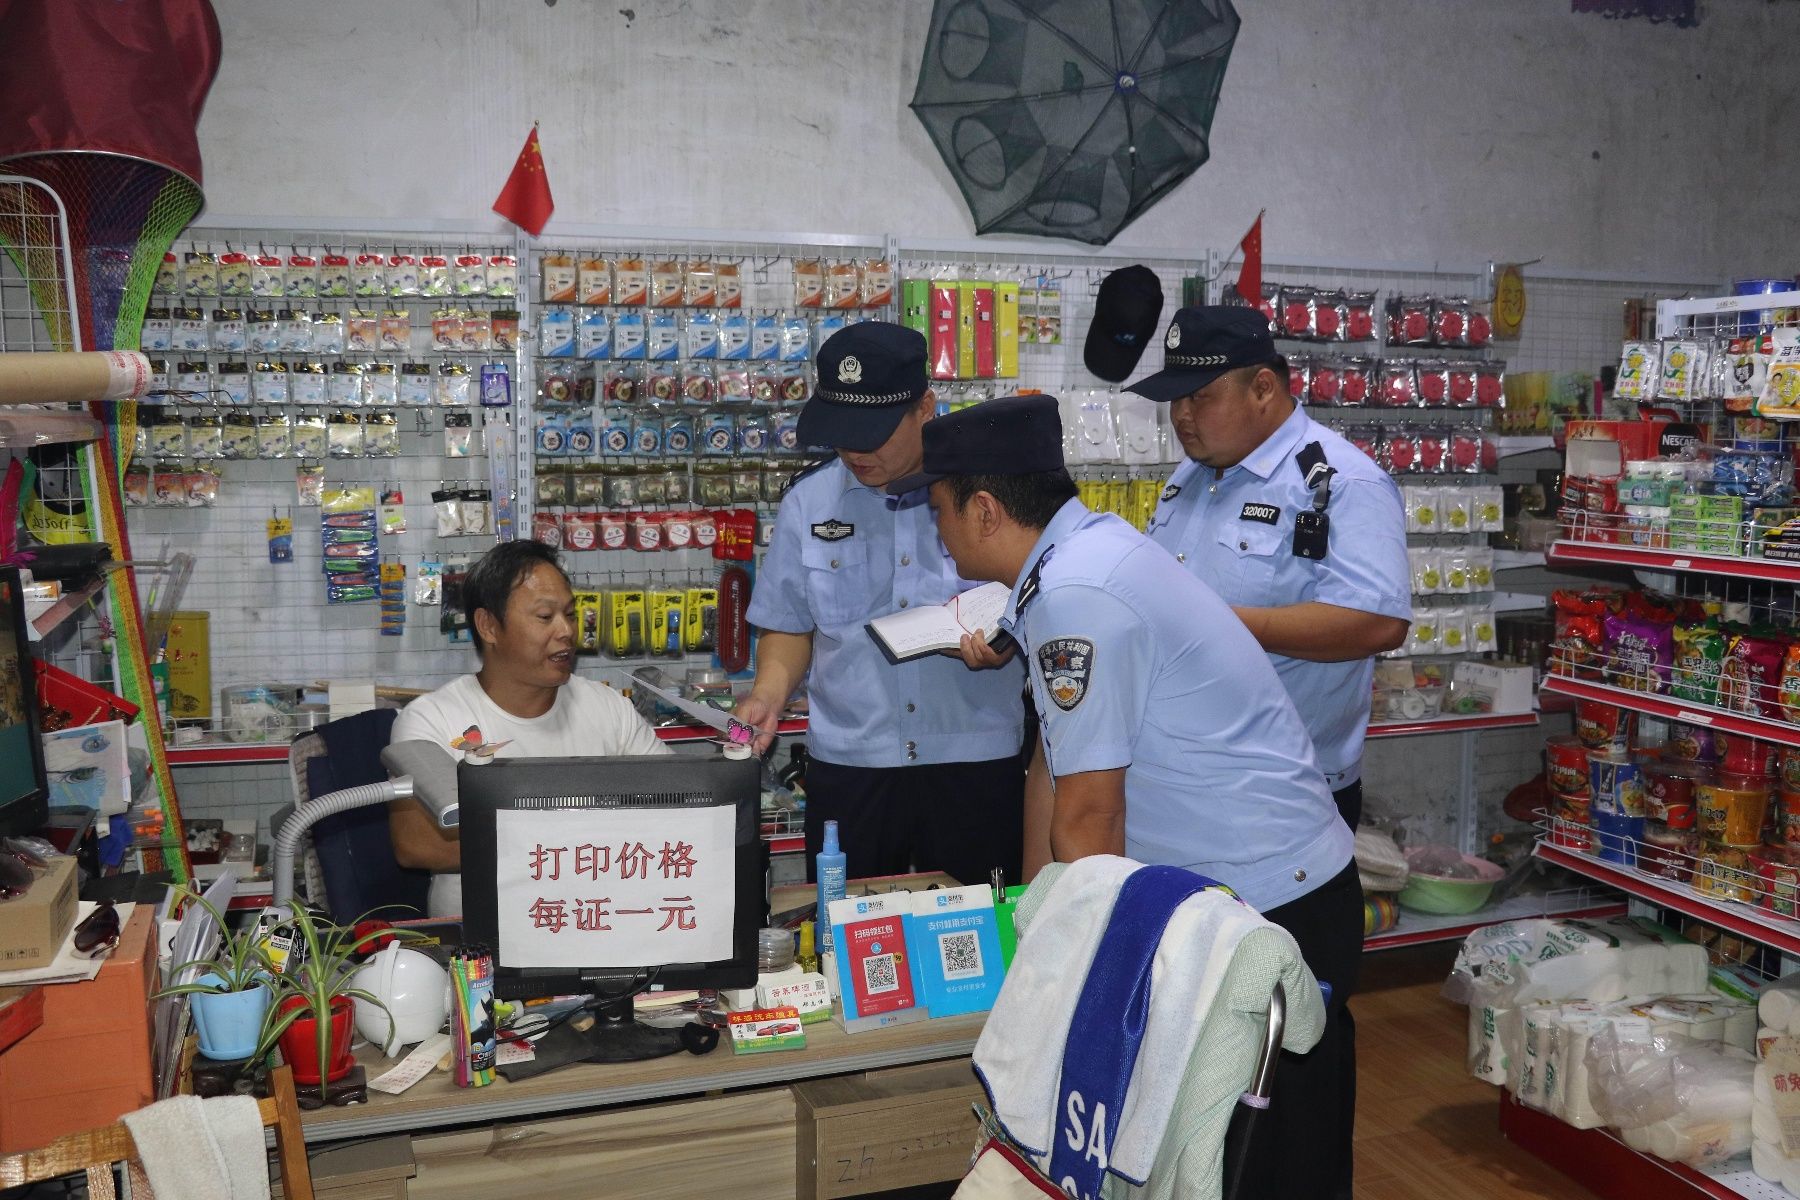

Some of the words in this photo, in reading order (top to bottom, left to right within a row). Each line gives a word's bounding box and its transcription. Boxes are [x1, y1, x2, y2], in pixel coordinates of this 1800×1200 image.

[1243, 505, 1276, 520] 320007
[528, 840, 698, 881] 打印价格
[528, 896, 698, 933] 每证一元
[854, 924, 894, 939] 扫码领红包
